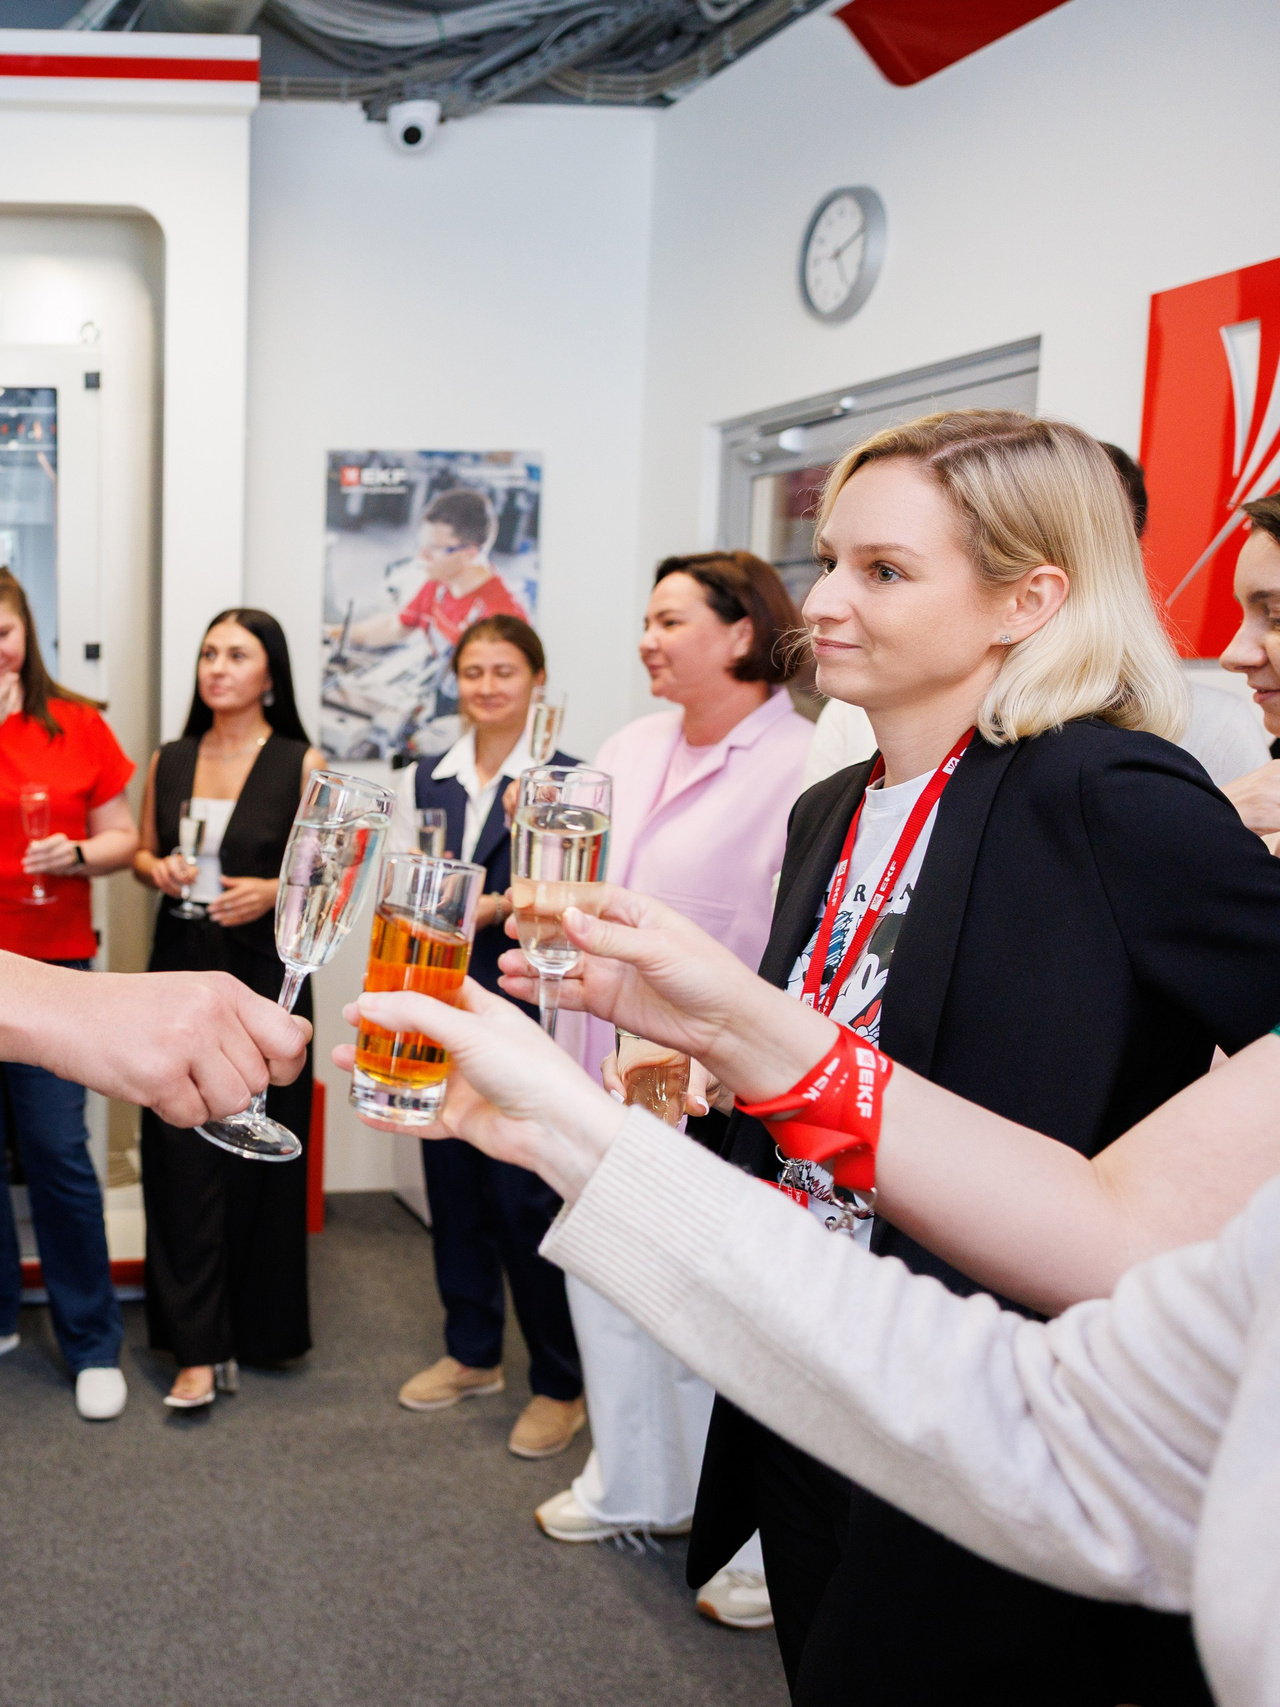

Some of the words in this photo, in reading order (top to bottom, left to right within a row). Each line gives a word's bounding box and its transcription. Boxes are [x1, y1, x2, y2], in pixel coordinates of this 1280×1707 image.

[880, 861, 896, 892] EKF
[831, 878, 842, 907] EKF
[856, 1069, 874, 1118] EKF
